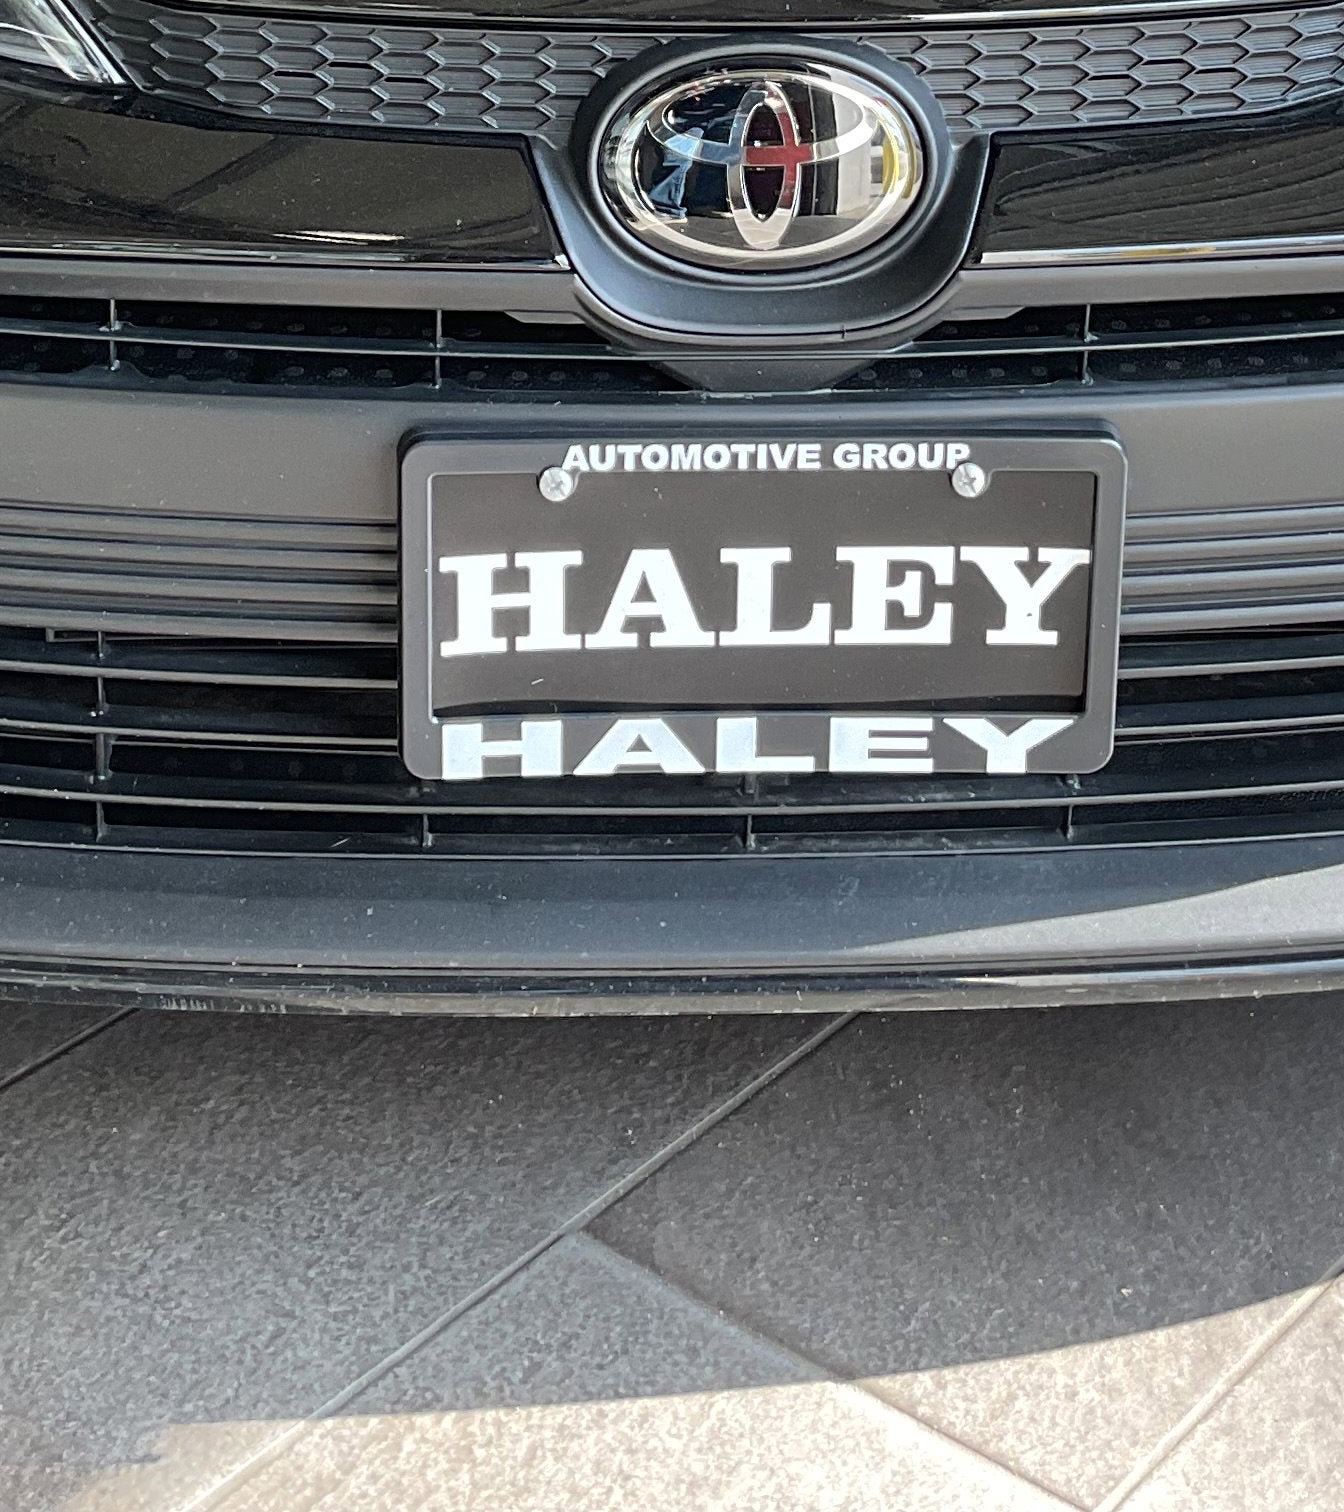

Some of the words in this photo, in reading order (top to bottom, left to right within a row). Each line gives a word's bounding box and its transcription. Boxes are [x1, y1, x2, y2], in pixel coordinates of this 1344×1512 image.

[562, 443, 821, 471] AUTOMOTIVE
[833, 442, 971, 470] GROUP
[439, 545, 1090, 657] HALEY
[441, 716, 1074, 781] HALEY
